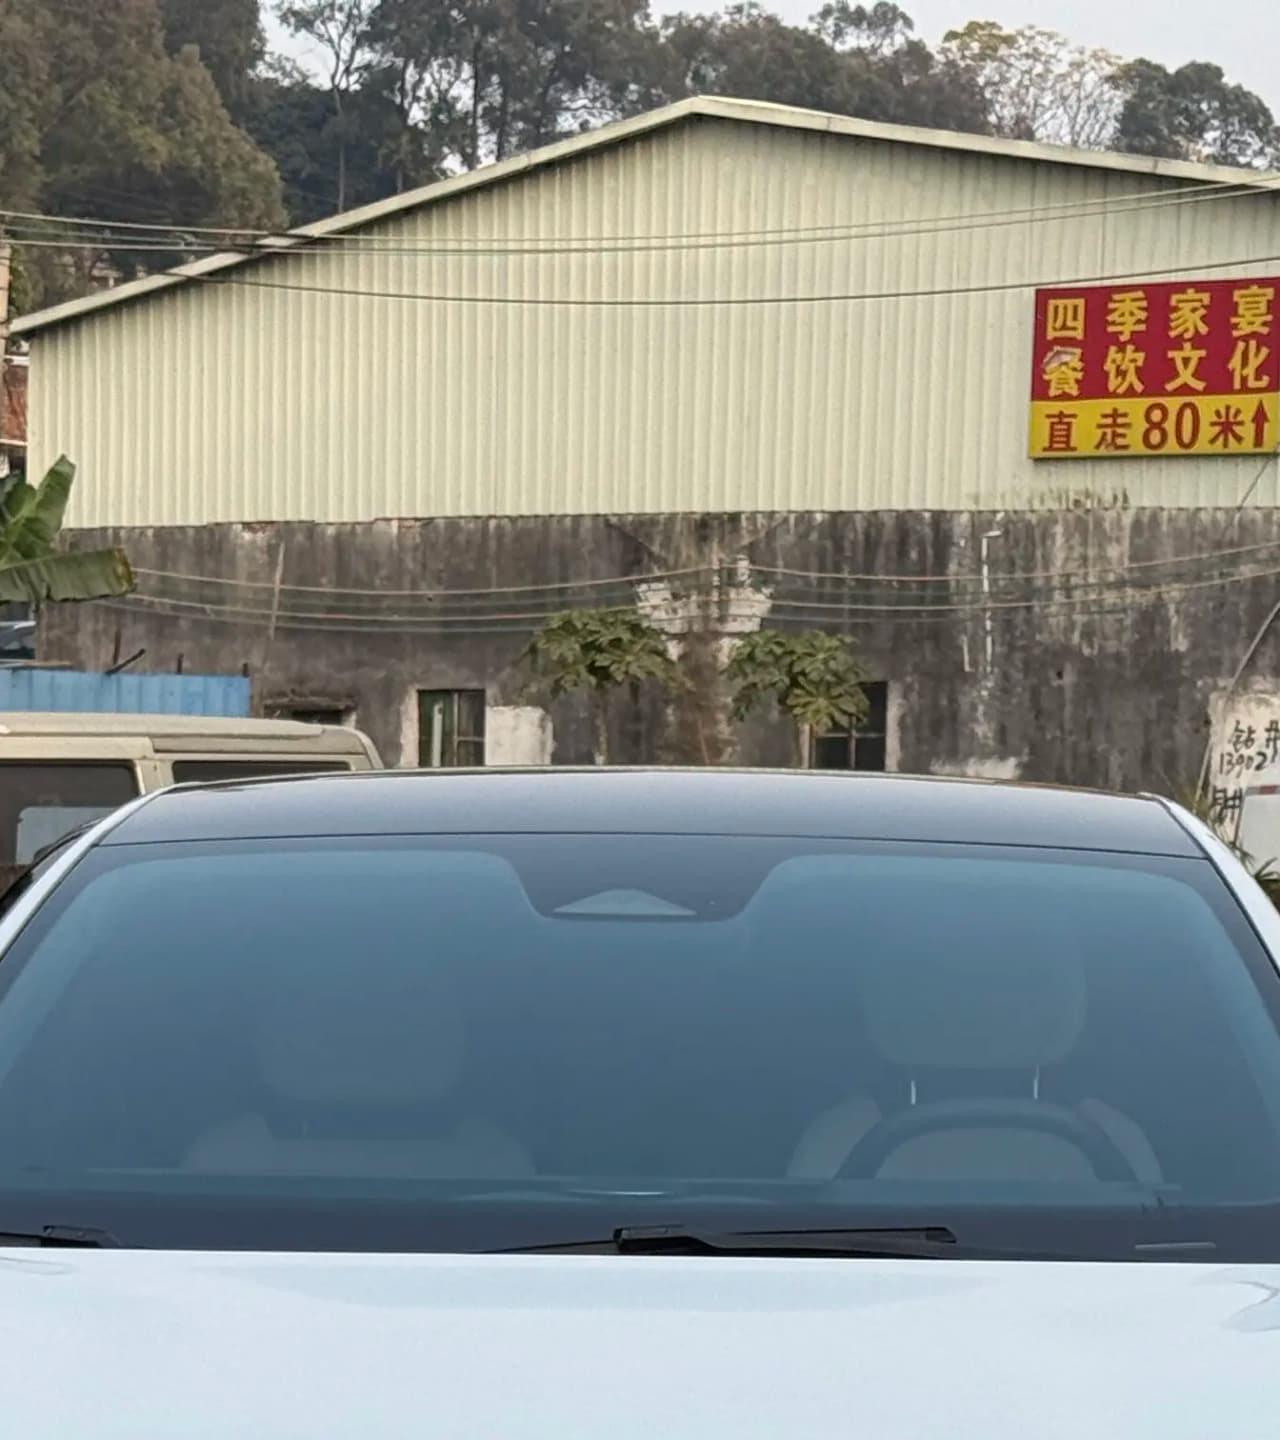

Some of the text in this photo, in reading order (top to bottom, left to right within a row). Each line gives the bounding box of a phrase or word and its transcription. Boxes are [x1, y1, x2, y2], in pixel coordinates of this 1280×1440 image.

[1045, 285, 1275, 342] 四季家宴
[1041, 339, 1271, 397] 餐饮文化
[1041, 401, 1245, 452] 直走80米
